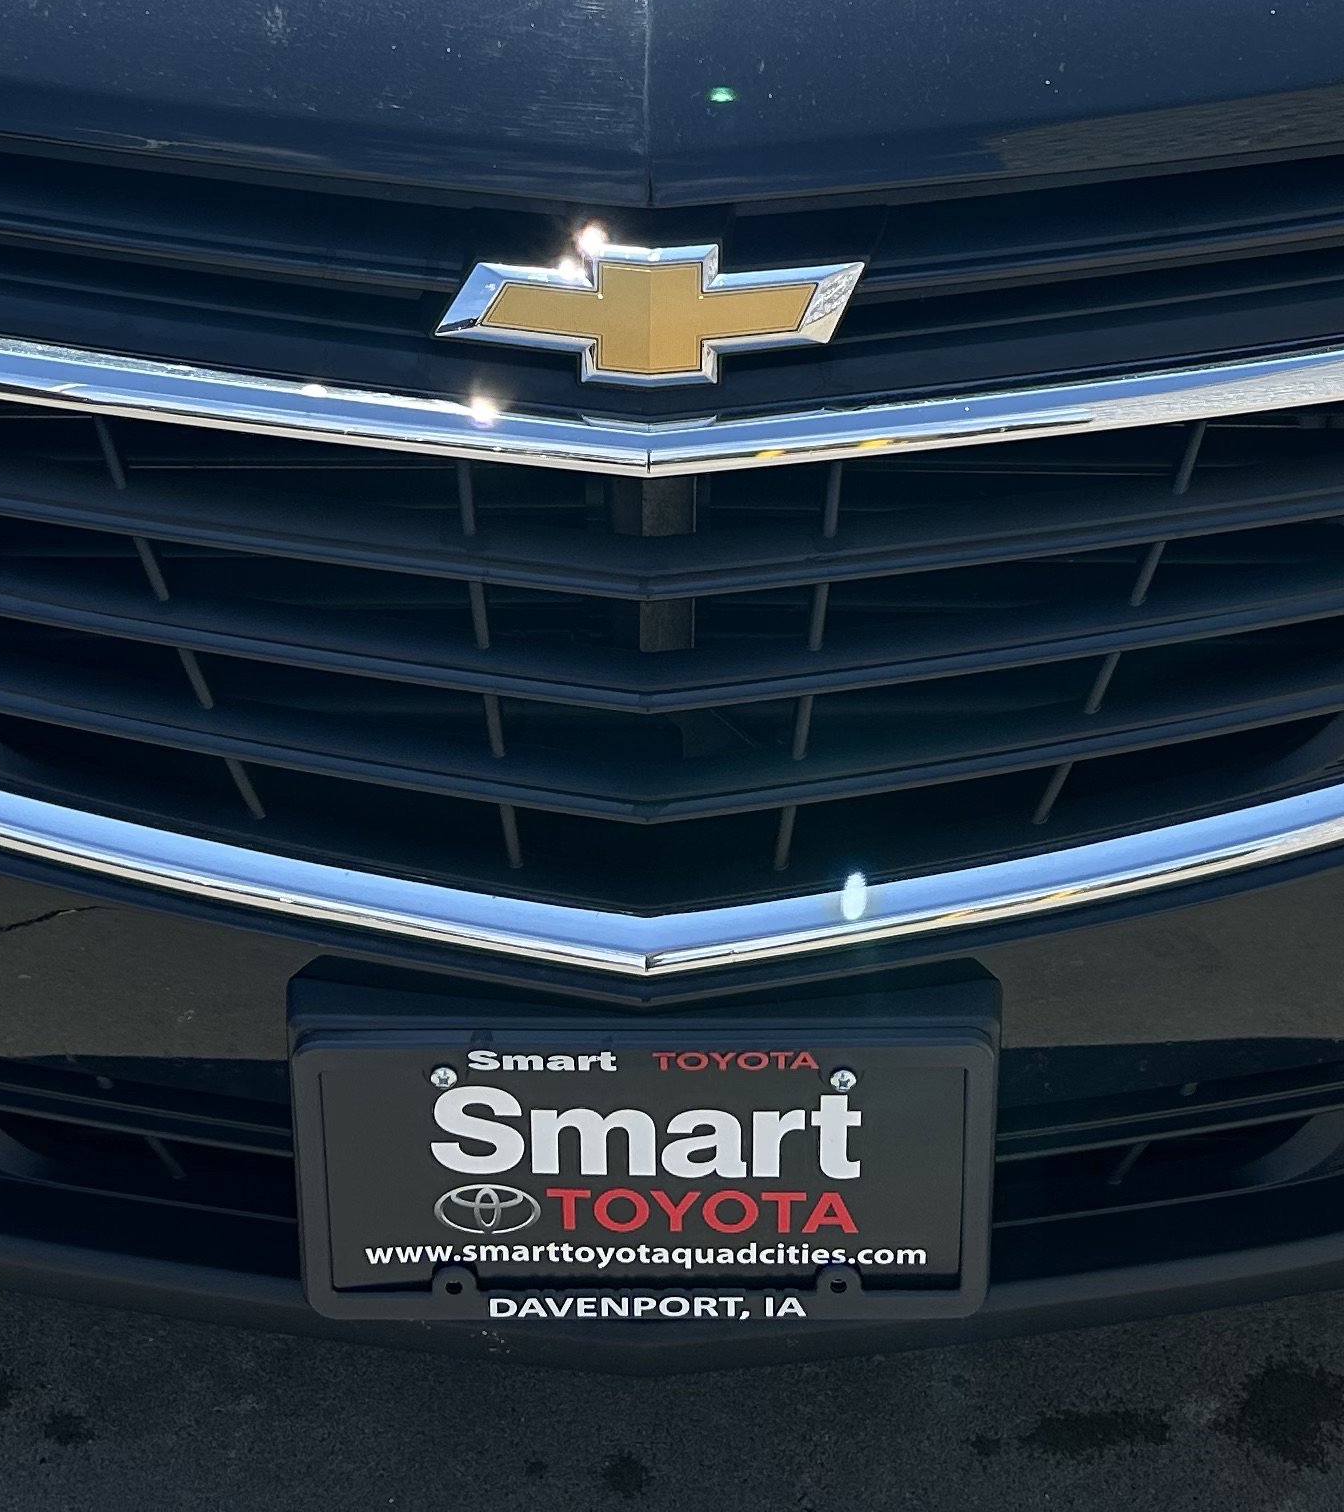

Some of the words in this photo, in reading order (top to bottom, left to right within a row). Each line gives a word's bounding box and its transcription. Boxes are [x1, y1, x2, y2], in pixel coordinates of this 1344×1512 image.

[467, 1049, 617, 1073] Smart
[653, 1051, 820, 1071] TOYOTA
[430, 1085, 862, 1180] Smart
[546, 1187, 857, 1234] TOYOTA
[364, 1241, 927, 1269] www.smarttoyotaquadcities.com
[488, 1295, 751, 1320] DAVENPORT,
[764, 1295, 808, 1318] IA
